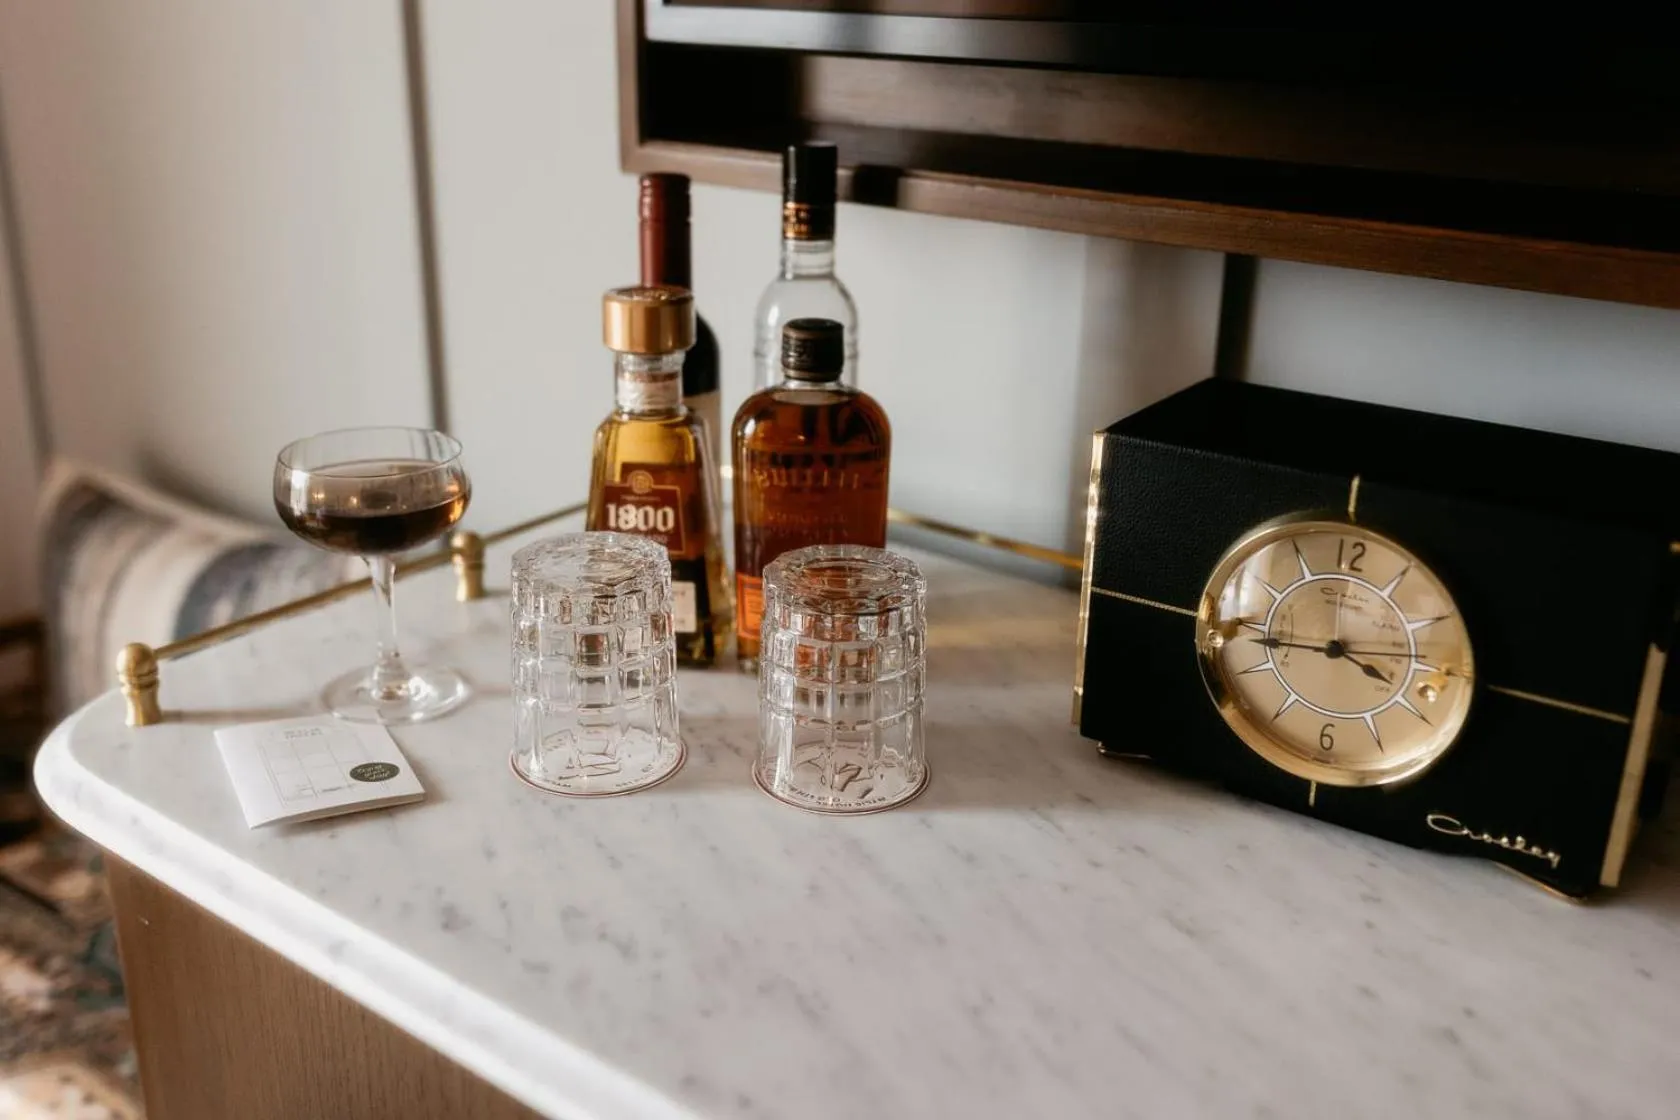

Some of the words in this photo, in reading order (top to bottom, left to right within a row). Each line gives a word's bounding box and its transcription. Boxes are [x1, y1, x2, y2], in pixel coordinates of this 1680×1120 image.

[606, 503, 675, 532] 1800
[1336, 538, 1366, 573] 12
[1319, 723, 1335, 751] 6
